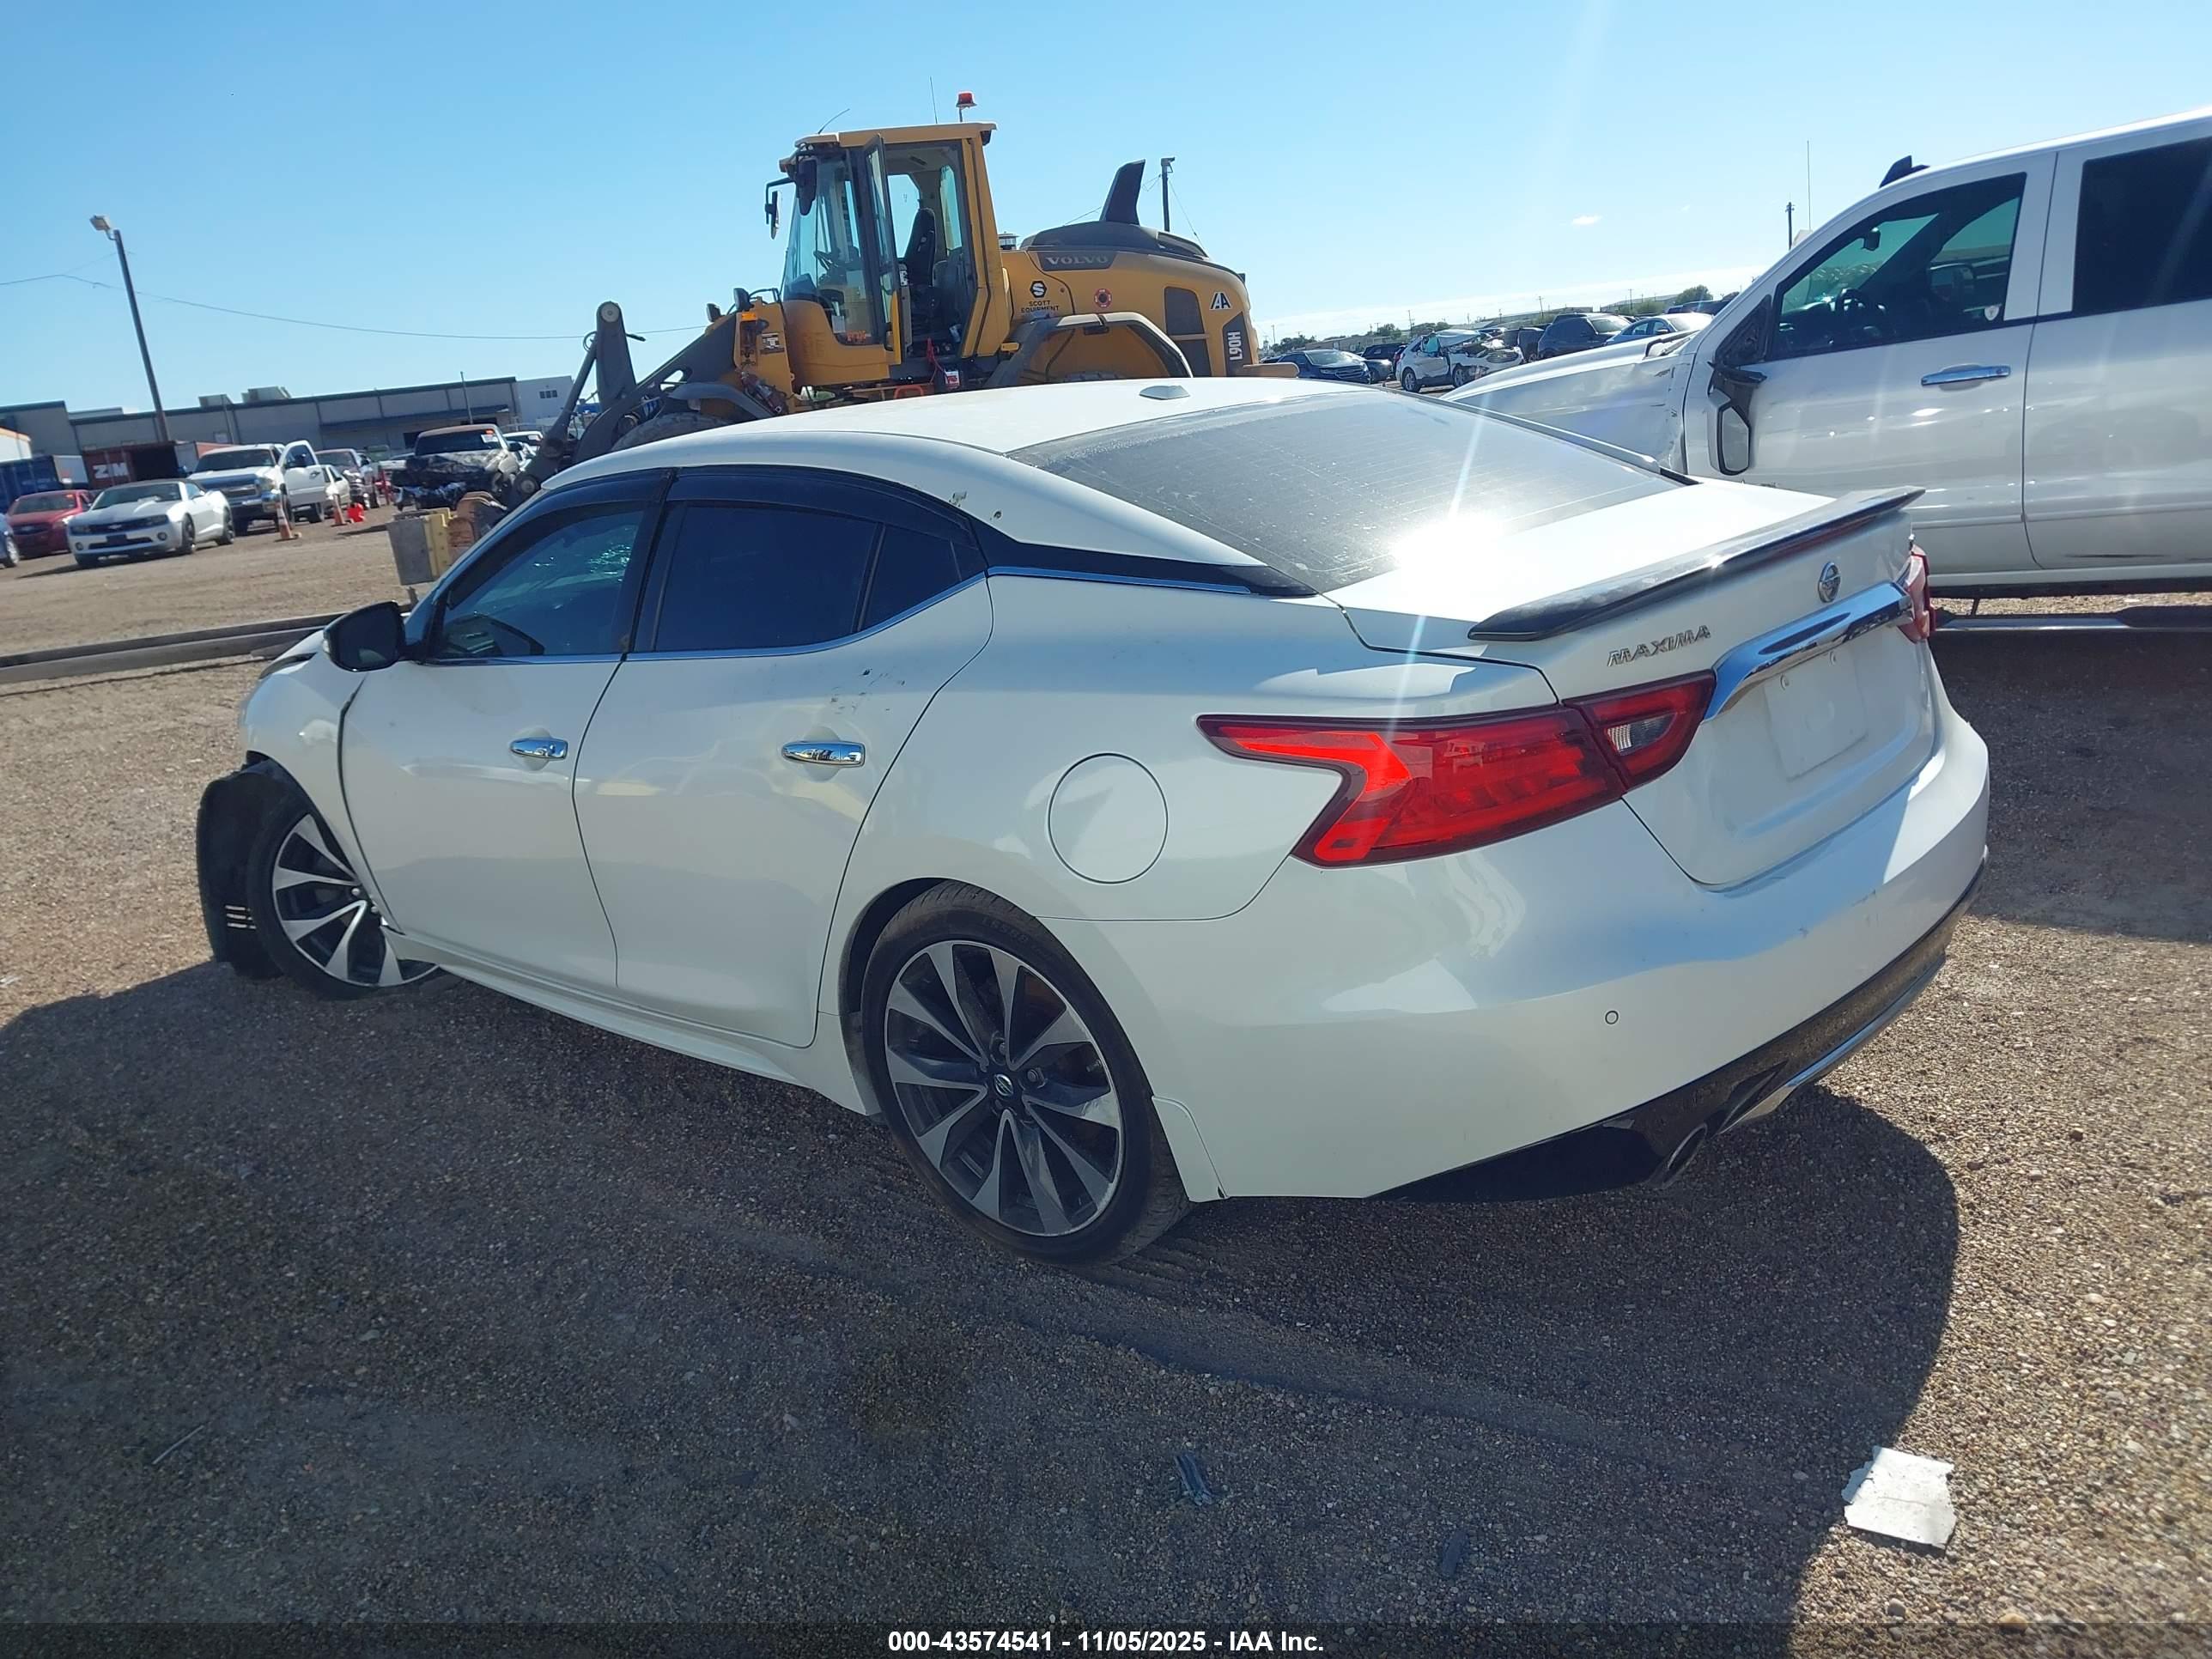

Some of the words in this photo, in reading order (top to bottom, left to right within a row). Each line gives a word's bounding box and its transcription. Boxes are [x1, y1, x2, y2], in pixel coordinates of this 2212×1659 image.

[1045, 256, 1109, 264] VOLVO
[1227, 331, 1243, 361] L90H
[1607, 625, 1711, 667] MAXIMA
